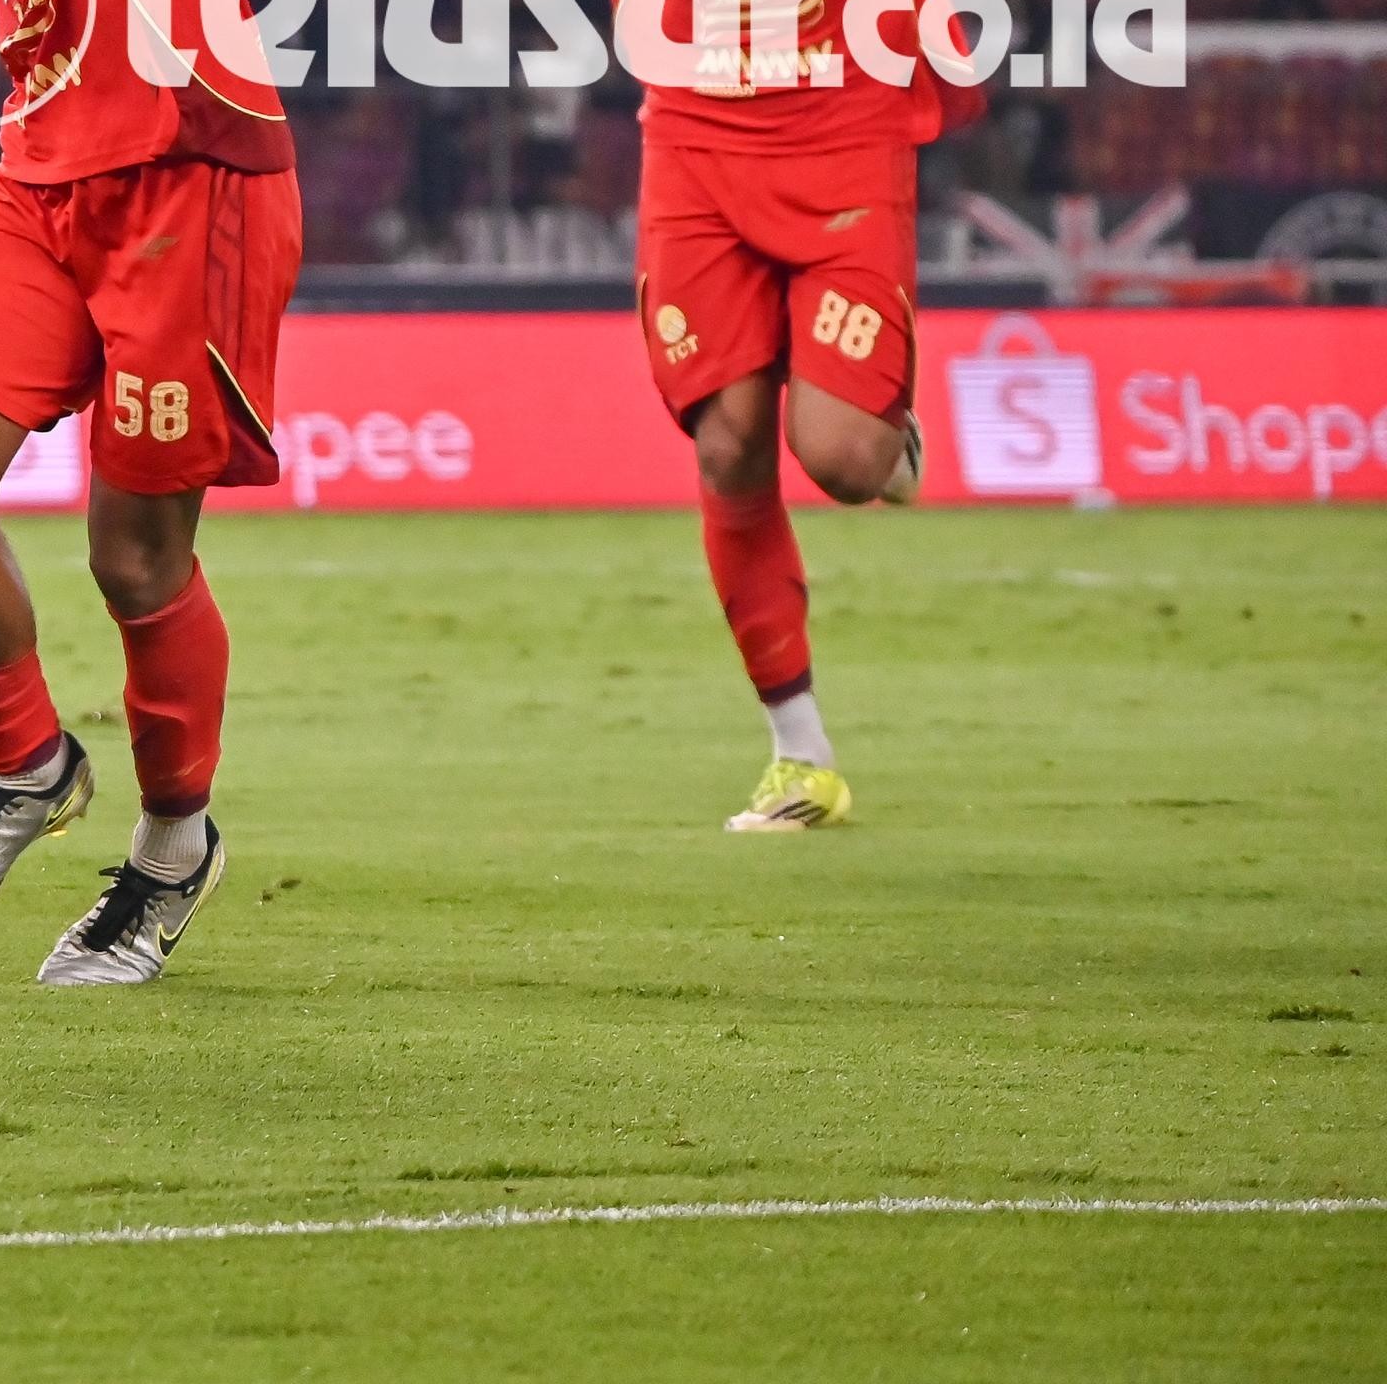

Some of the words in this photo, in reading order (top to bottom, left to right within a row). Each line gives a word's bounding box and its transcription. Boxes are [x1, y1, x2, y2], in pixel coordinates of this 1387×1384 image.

[812, 288, 884, 361] 88
[113, 370, 191, 443] 58
[1119, 369, 1387, 500] Shop
